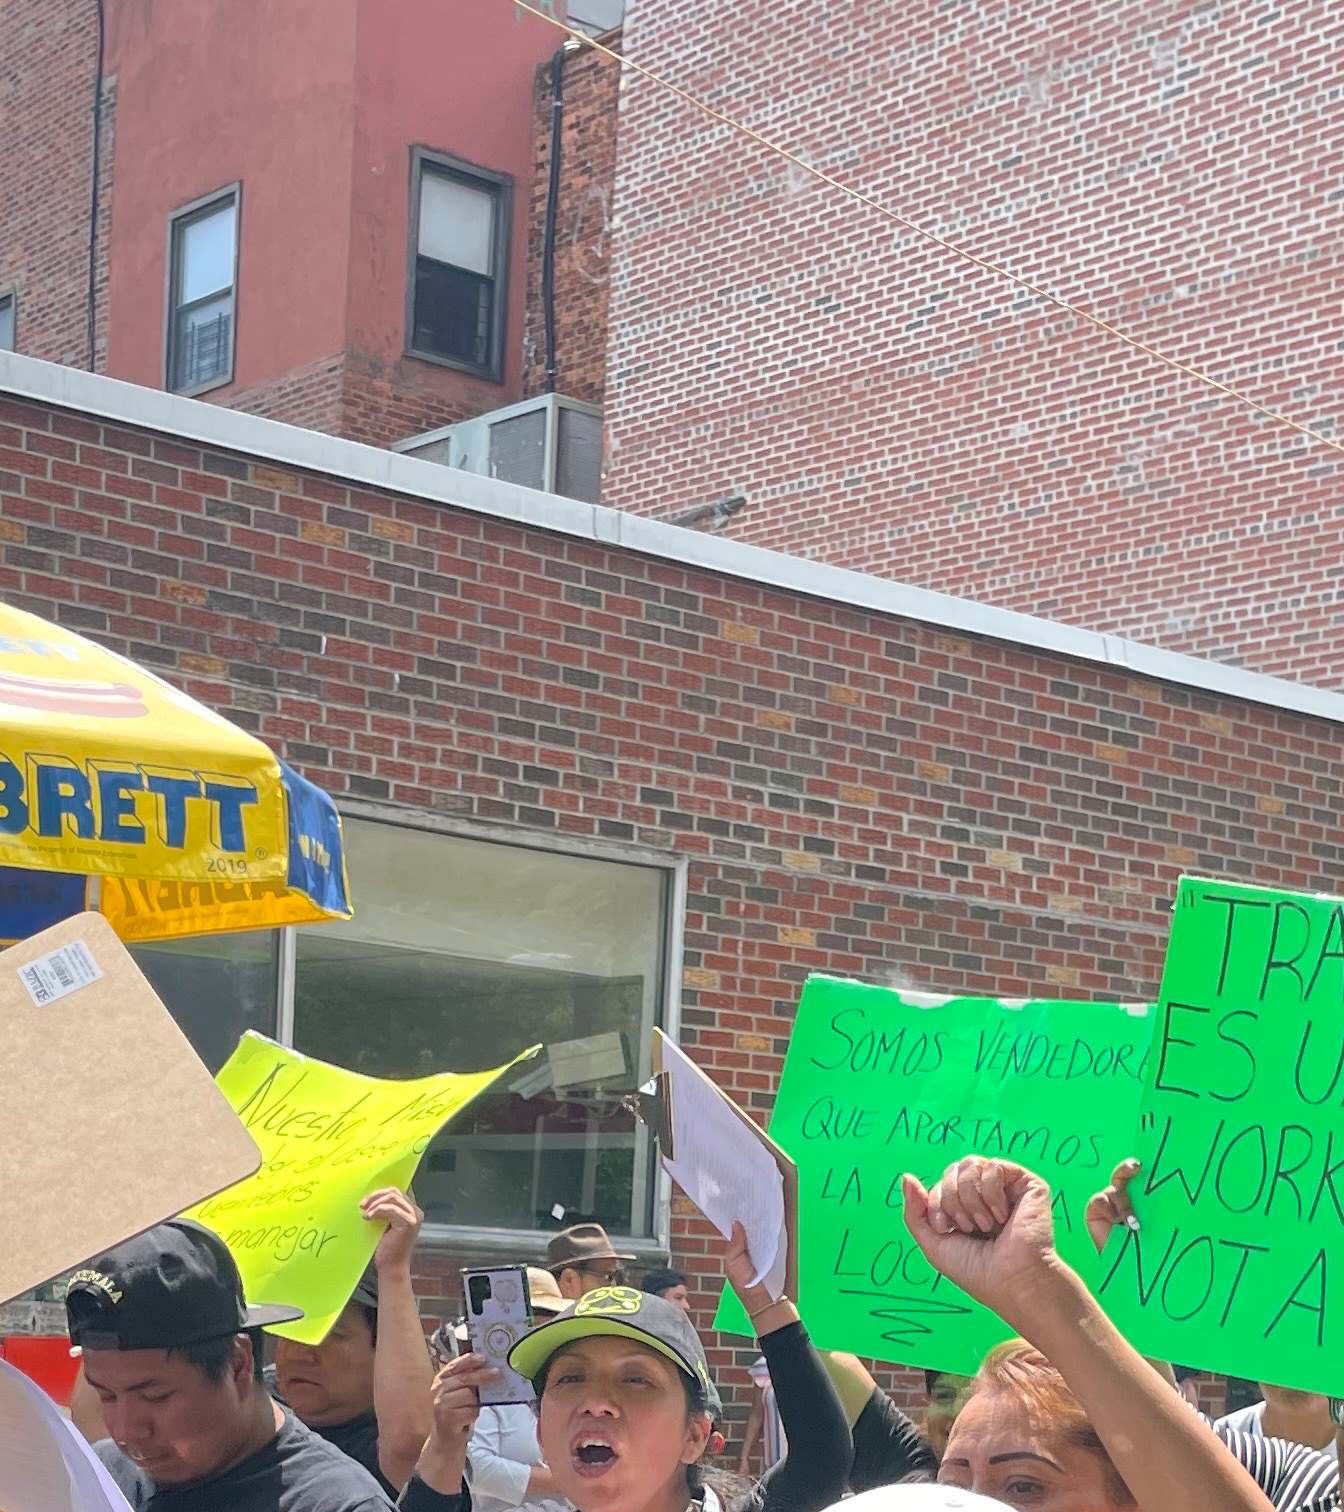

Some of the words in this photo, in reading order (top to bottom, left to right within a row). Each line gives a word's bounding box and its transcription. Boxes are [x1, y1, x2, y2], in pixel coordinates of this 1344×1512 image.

[207, 858, 249, 873] 2019
[810, 1007, 947, 1076] SOMOS
[1155, 999, 1258, 1102] ES
[801, 1095, 880, 1145] QUE
[885, 1105, 1104, 1169] APORTAMOS
[820, 1166, 863, 1206] LA
[1098, 1228, 1269, 1328] NOT
[1263, 1247, 1328, 1348] A
